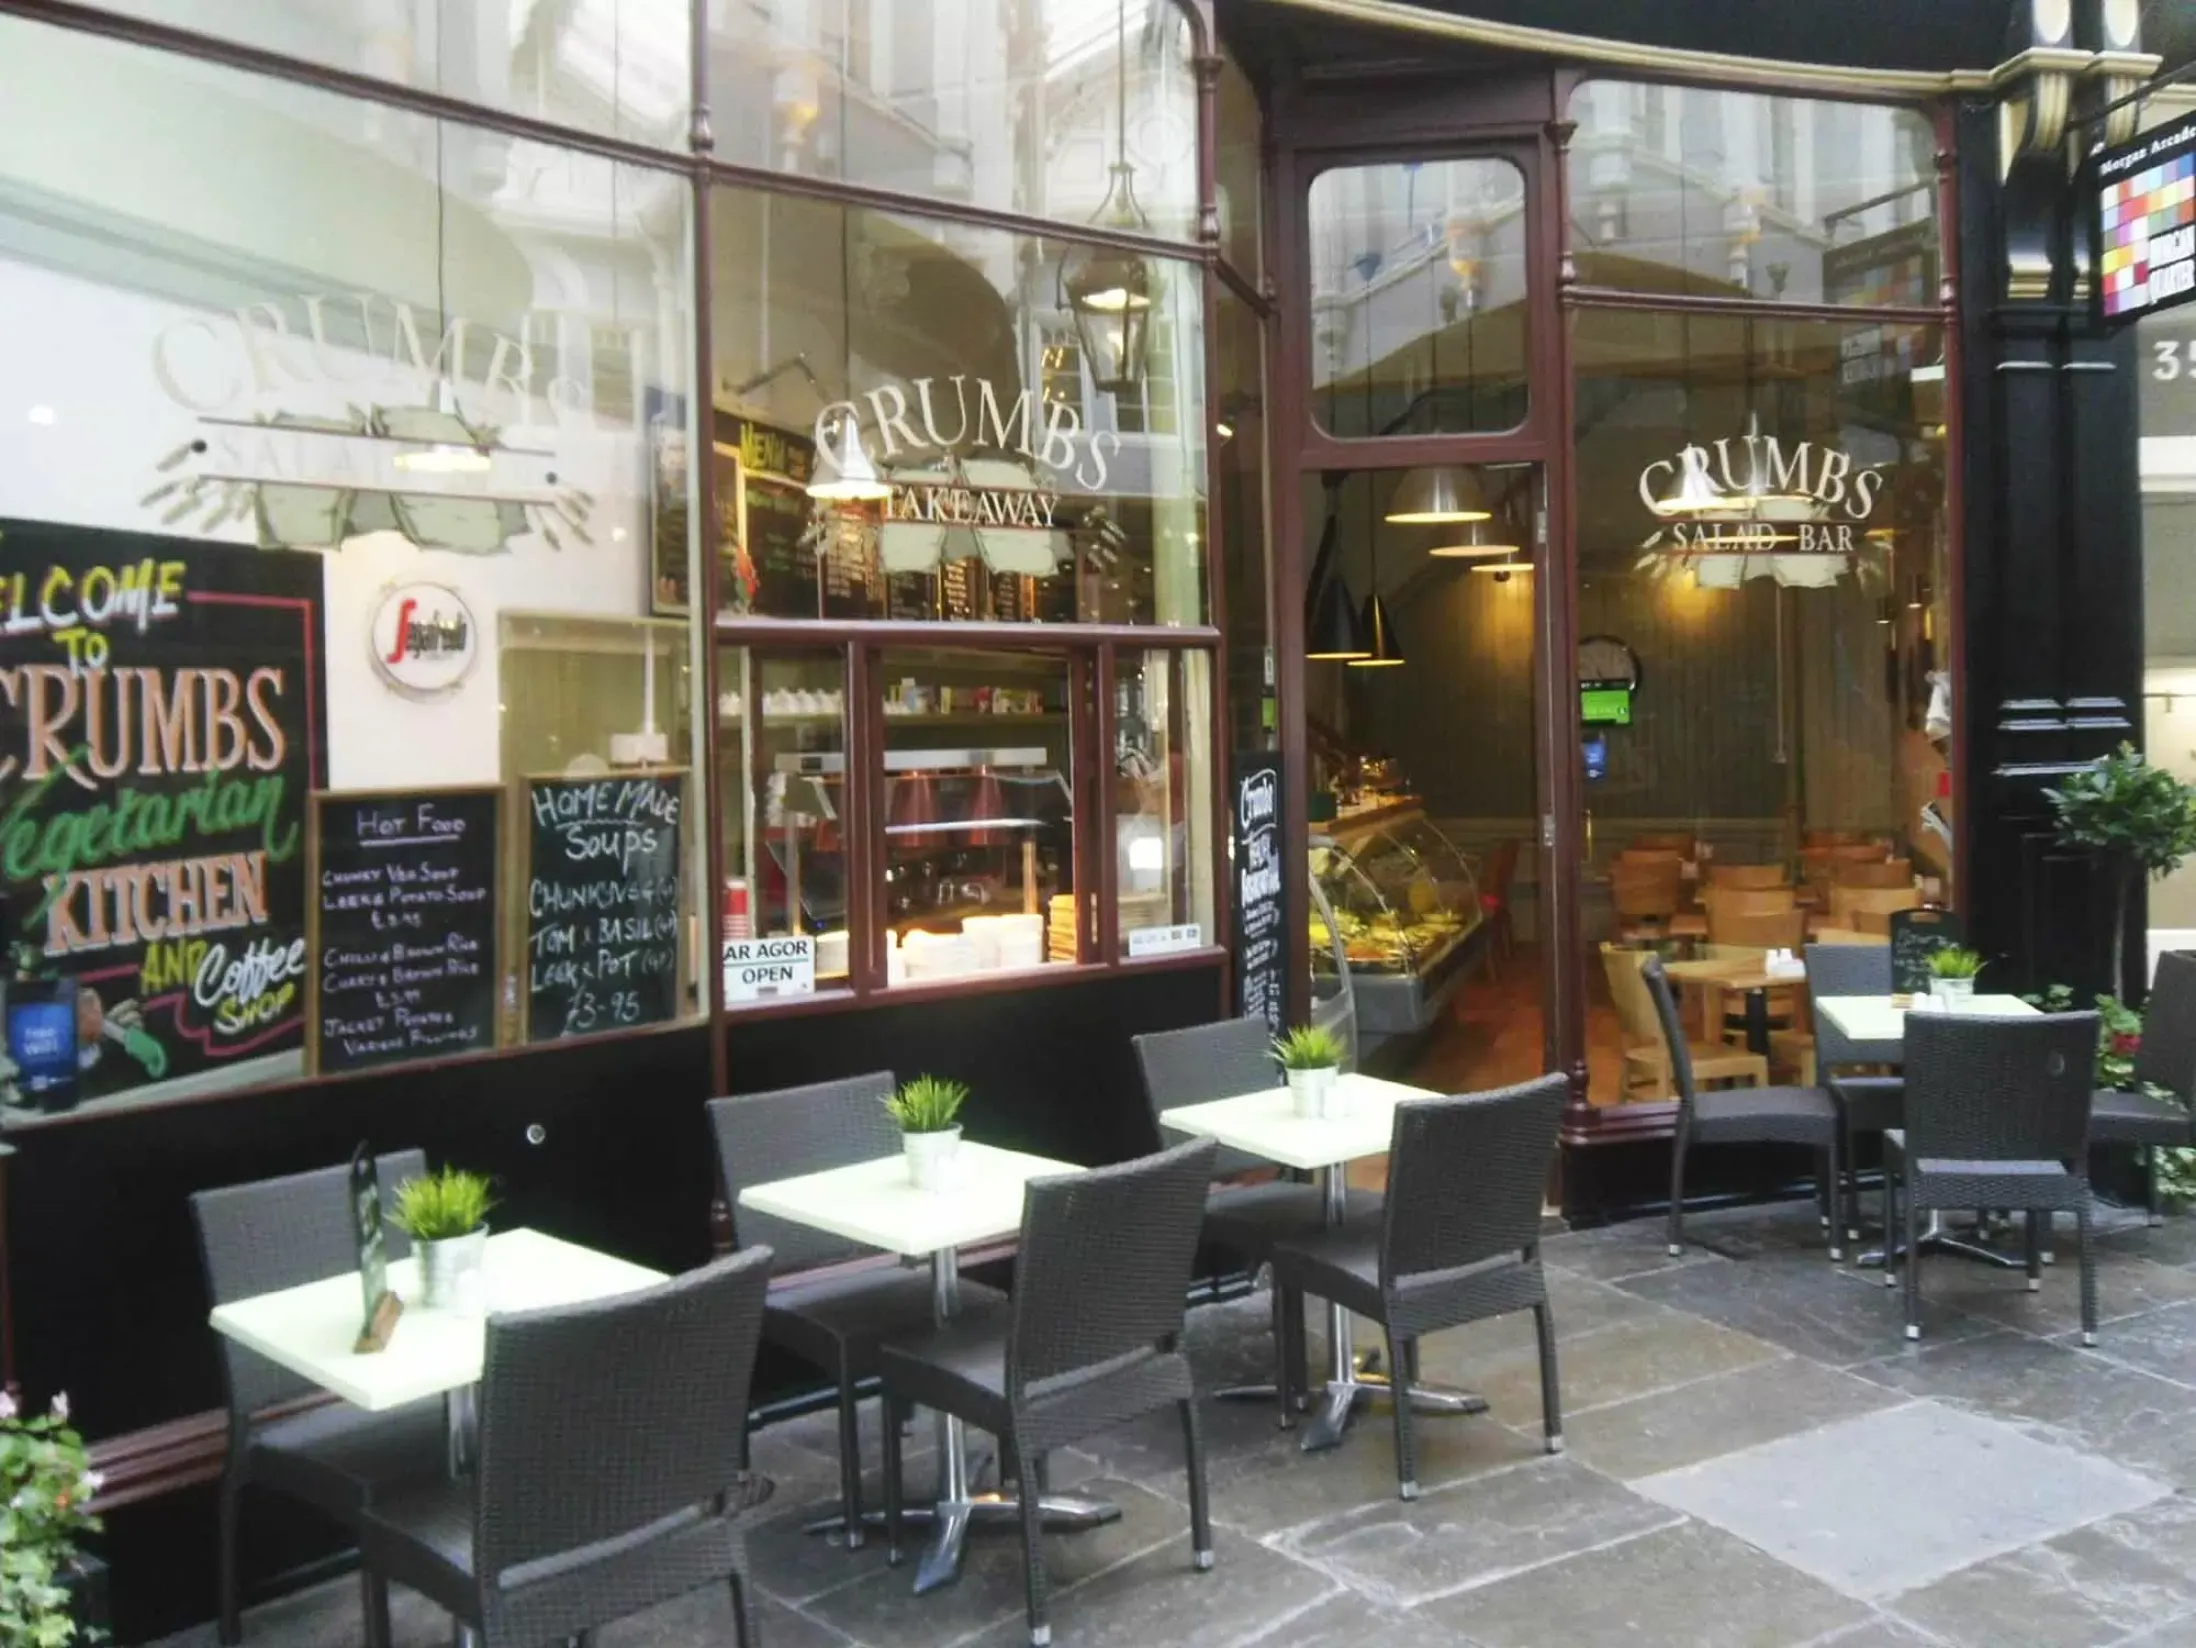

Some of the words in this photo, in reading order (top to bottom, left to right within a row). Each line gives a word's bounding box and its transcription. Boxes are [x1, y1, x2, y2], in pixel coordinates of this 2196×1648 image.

[2100, 147, 2148, 176] Morgan
[815, 374, 1121, 491] CRUMBS
[1638, 435, 1883, 520] CRUMBS
[885, 485, 1061, 528] TAKEAWAY
[1672, 522, 1777, 552] SALAD
[1798, 523, 1854, 553] BAR
[0, 557, 187, 635] LCOME
[53, 626, 109, 679] TO
[532, 783, 613, 827] HOME
[43, 852, 269, 957] KITCHEN
[598, 917, 653, 944] BASIL
[723, 944, 751, 961] AR
[756, 940, 808, 959] AGOR
[141, 938, 208, 994] AND
[195, 937, 309, 1007] Coffee
[741, 966, 793, 985] OPEN
[214, 982, 296, 1035] SHOP
